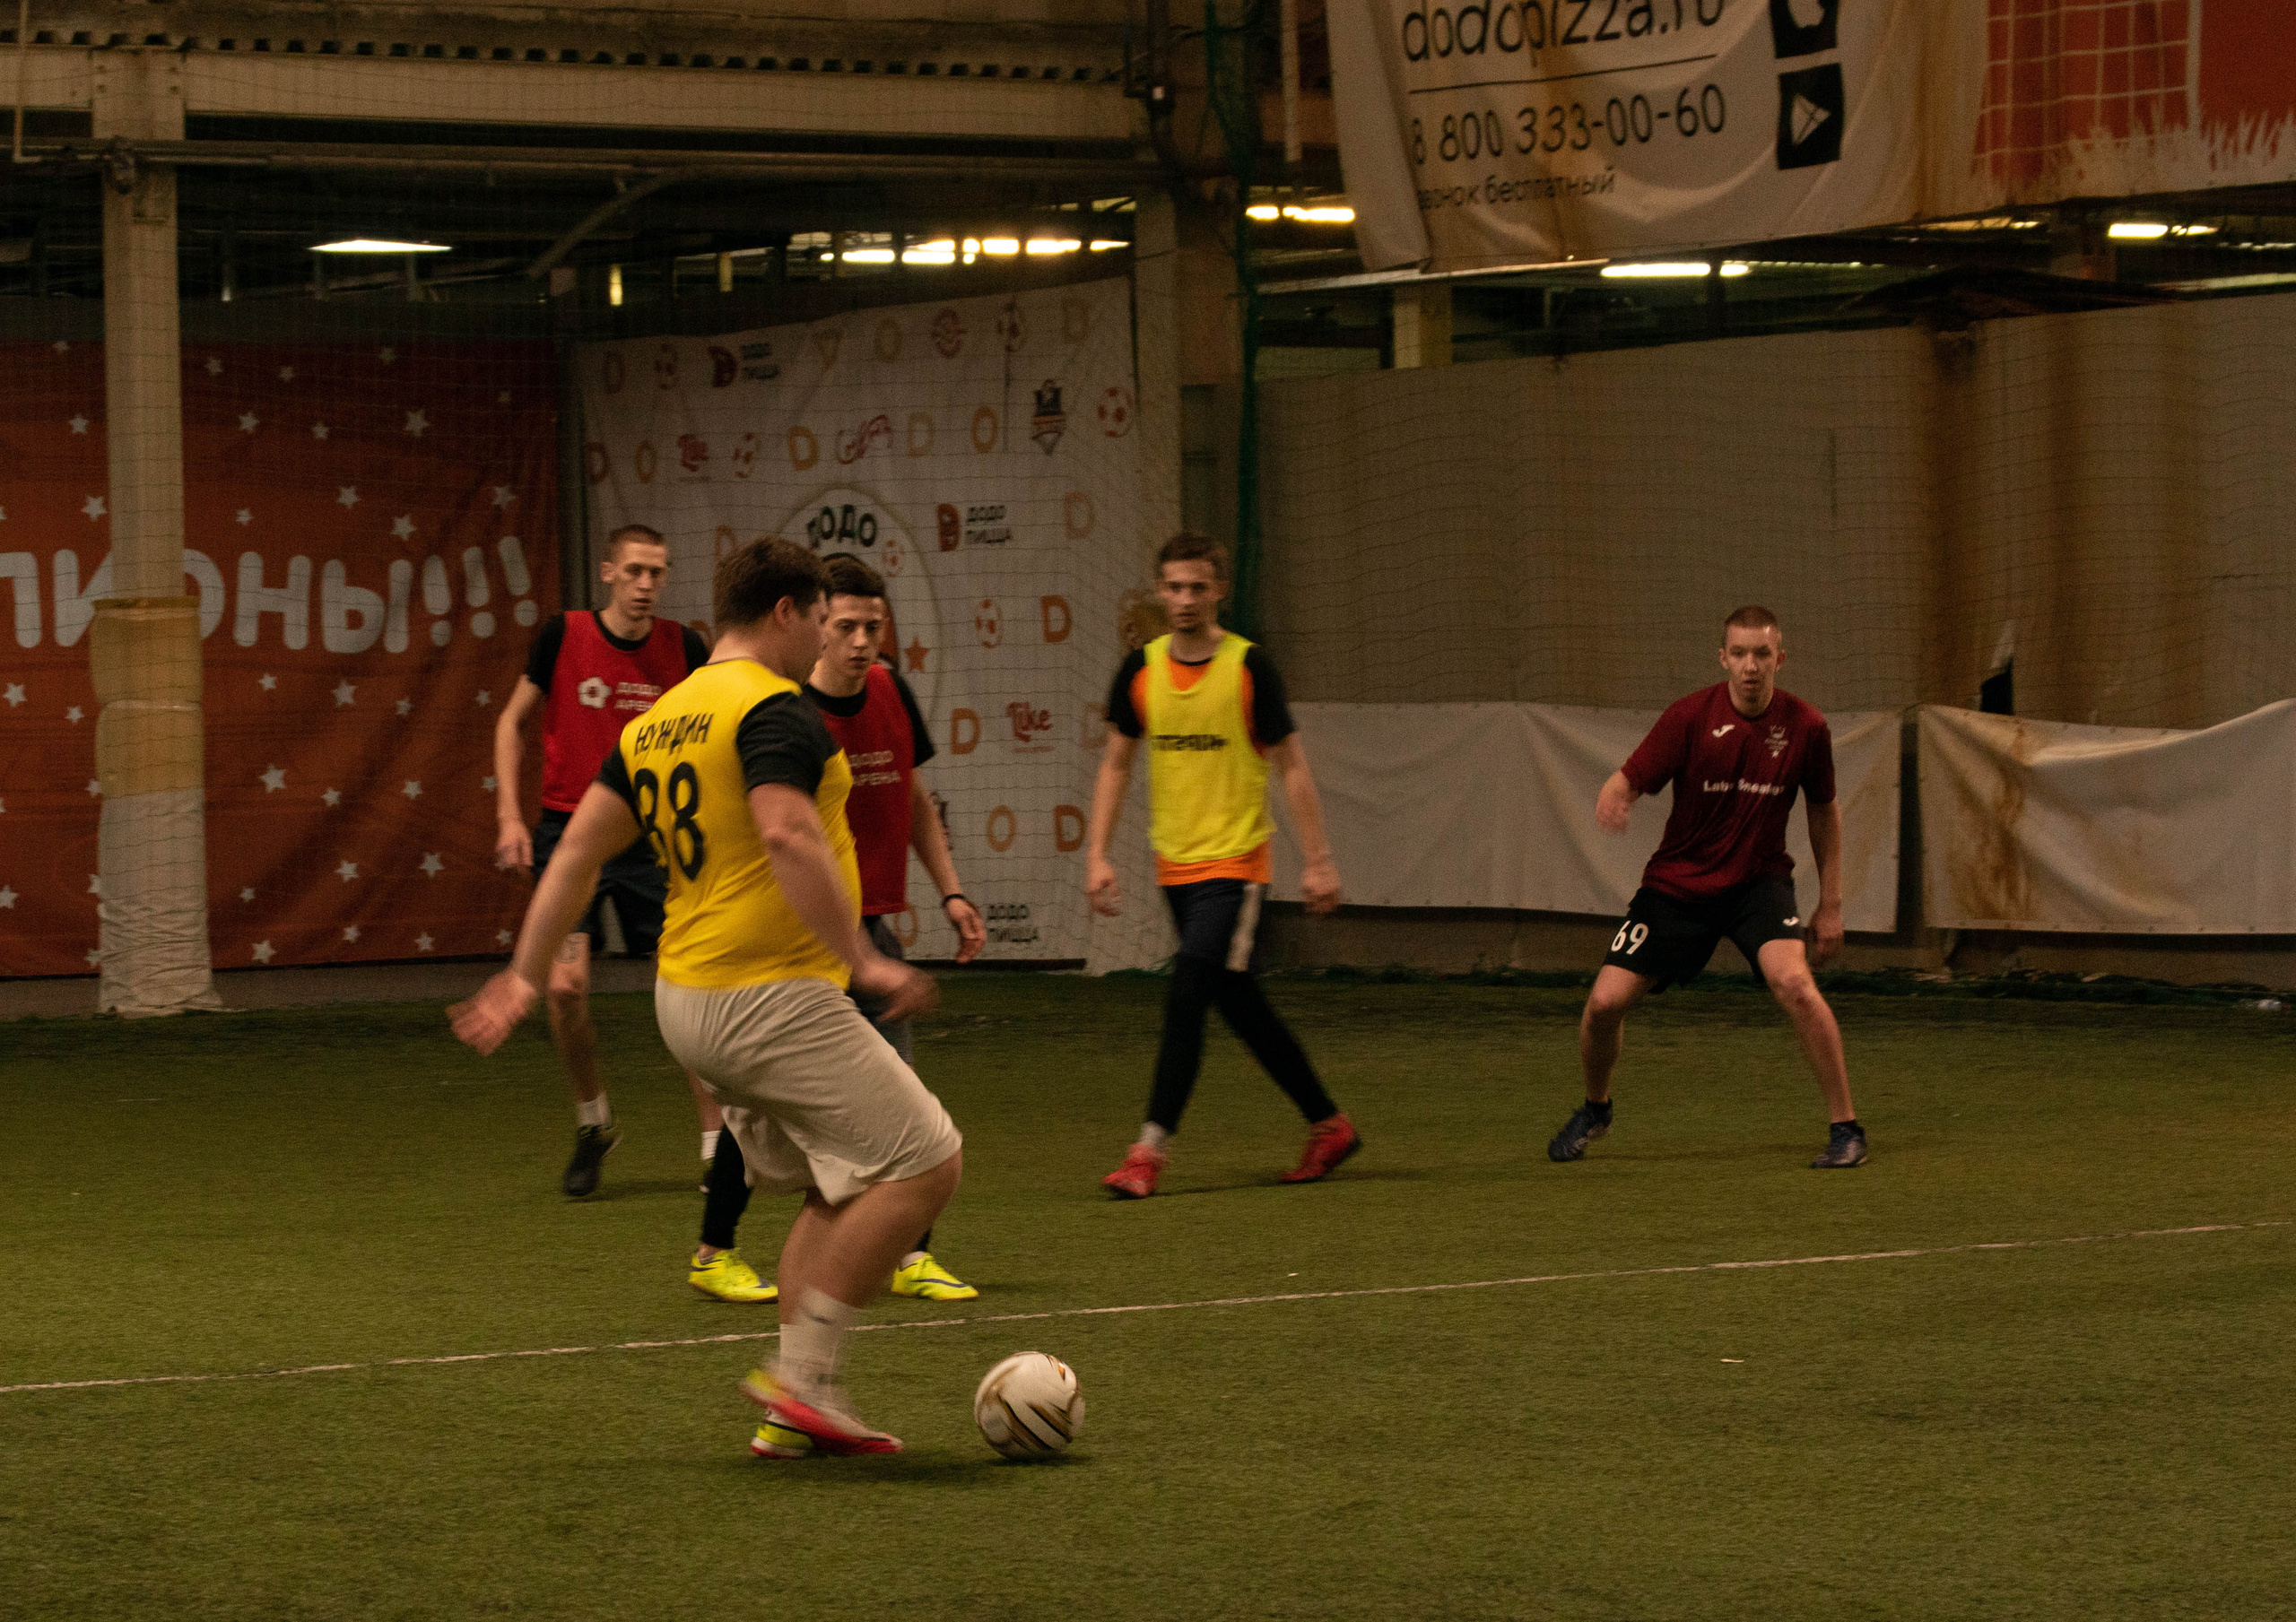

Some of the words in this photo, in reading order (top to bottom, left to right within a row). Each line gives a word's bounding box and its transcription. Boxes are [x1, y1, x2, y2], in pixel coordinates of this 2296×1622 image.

[1439, 109, 1504, 161] 800
[1515, 83, 1726, 156] 333-00-60
[633, 714, 714, 757] НУЖДИН
[1611, 920, 1649, 956] 69
